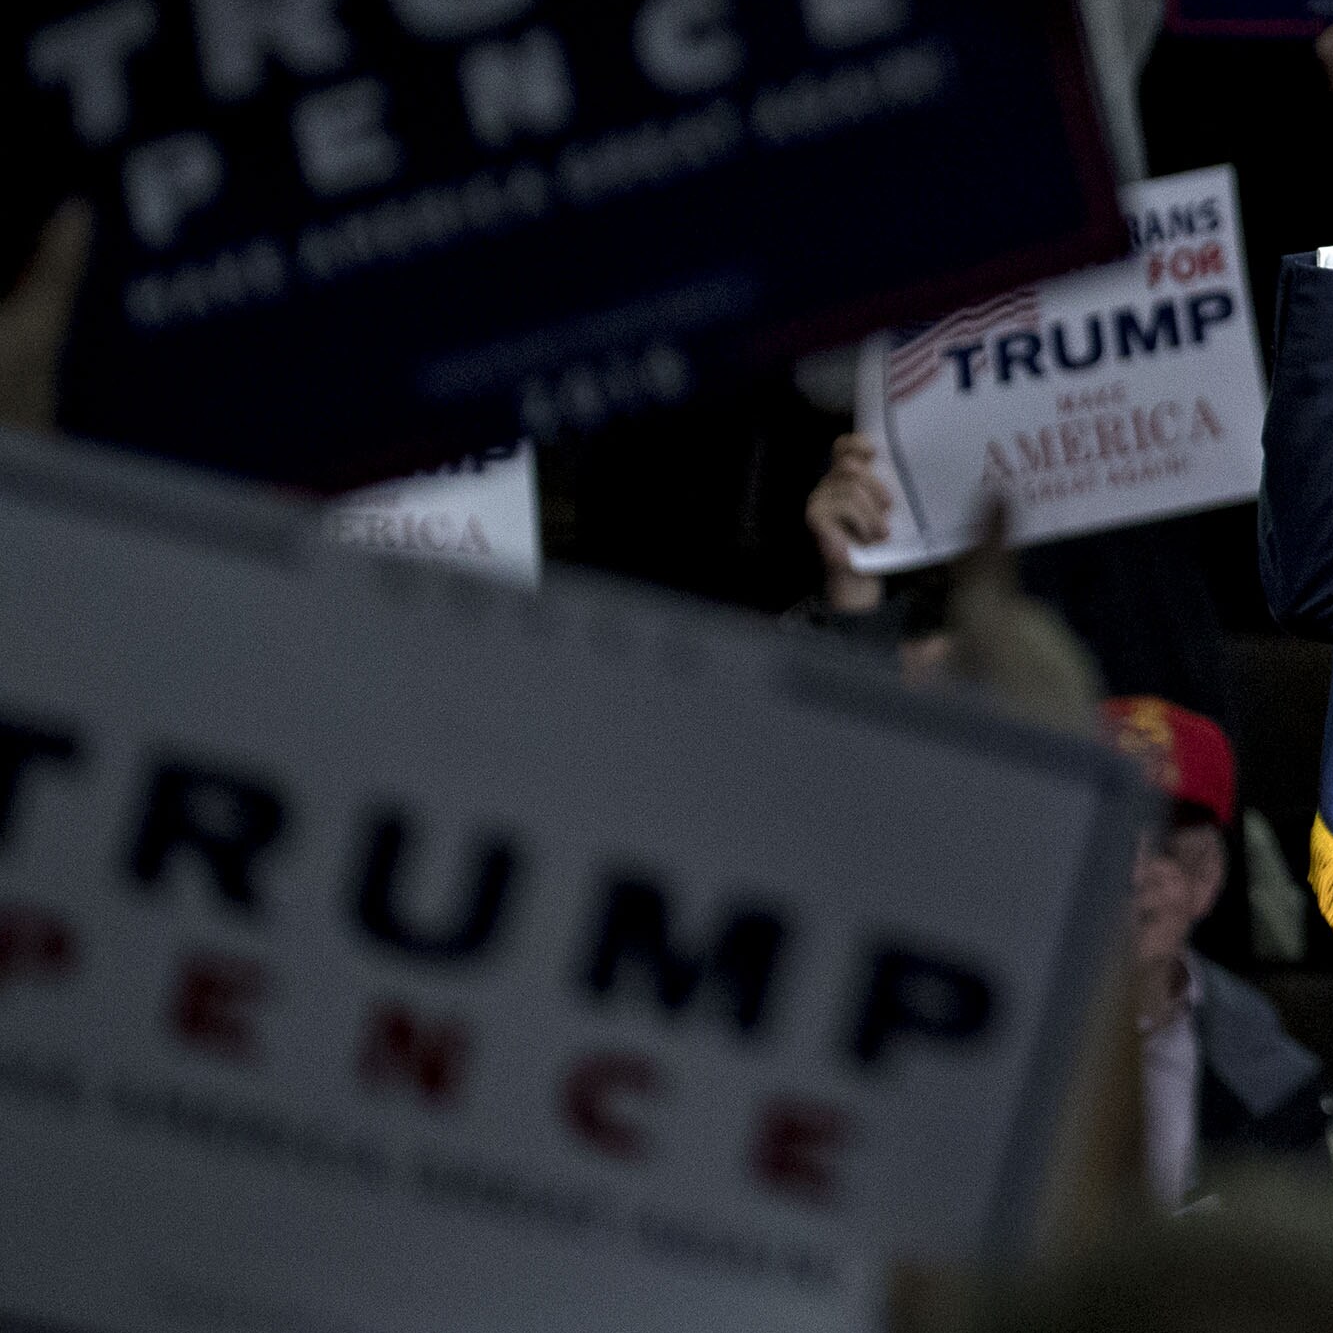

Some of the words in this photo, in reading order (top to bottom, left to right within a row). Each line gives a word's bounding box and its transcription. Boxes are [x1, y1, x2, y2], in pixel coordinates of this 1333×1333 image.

[1147, 242, 1224, 286] FOR
[943, 289, 1235, 392] TRUMP
[983, 396, 1223, 485] AMERICA
